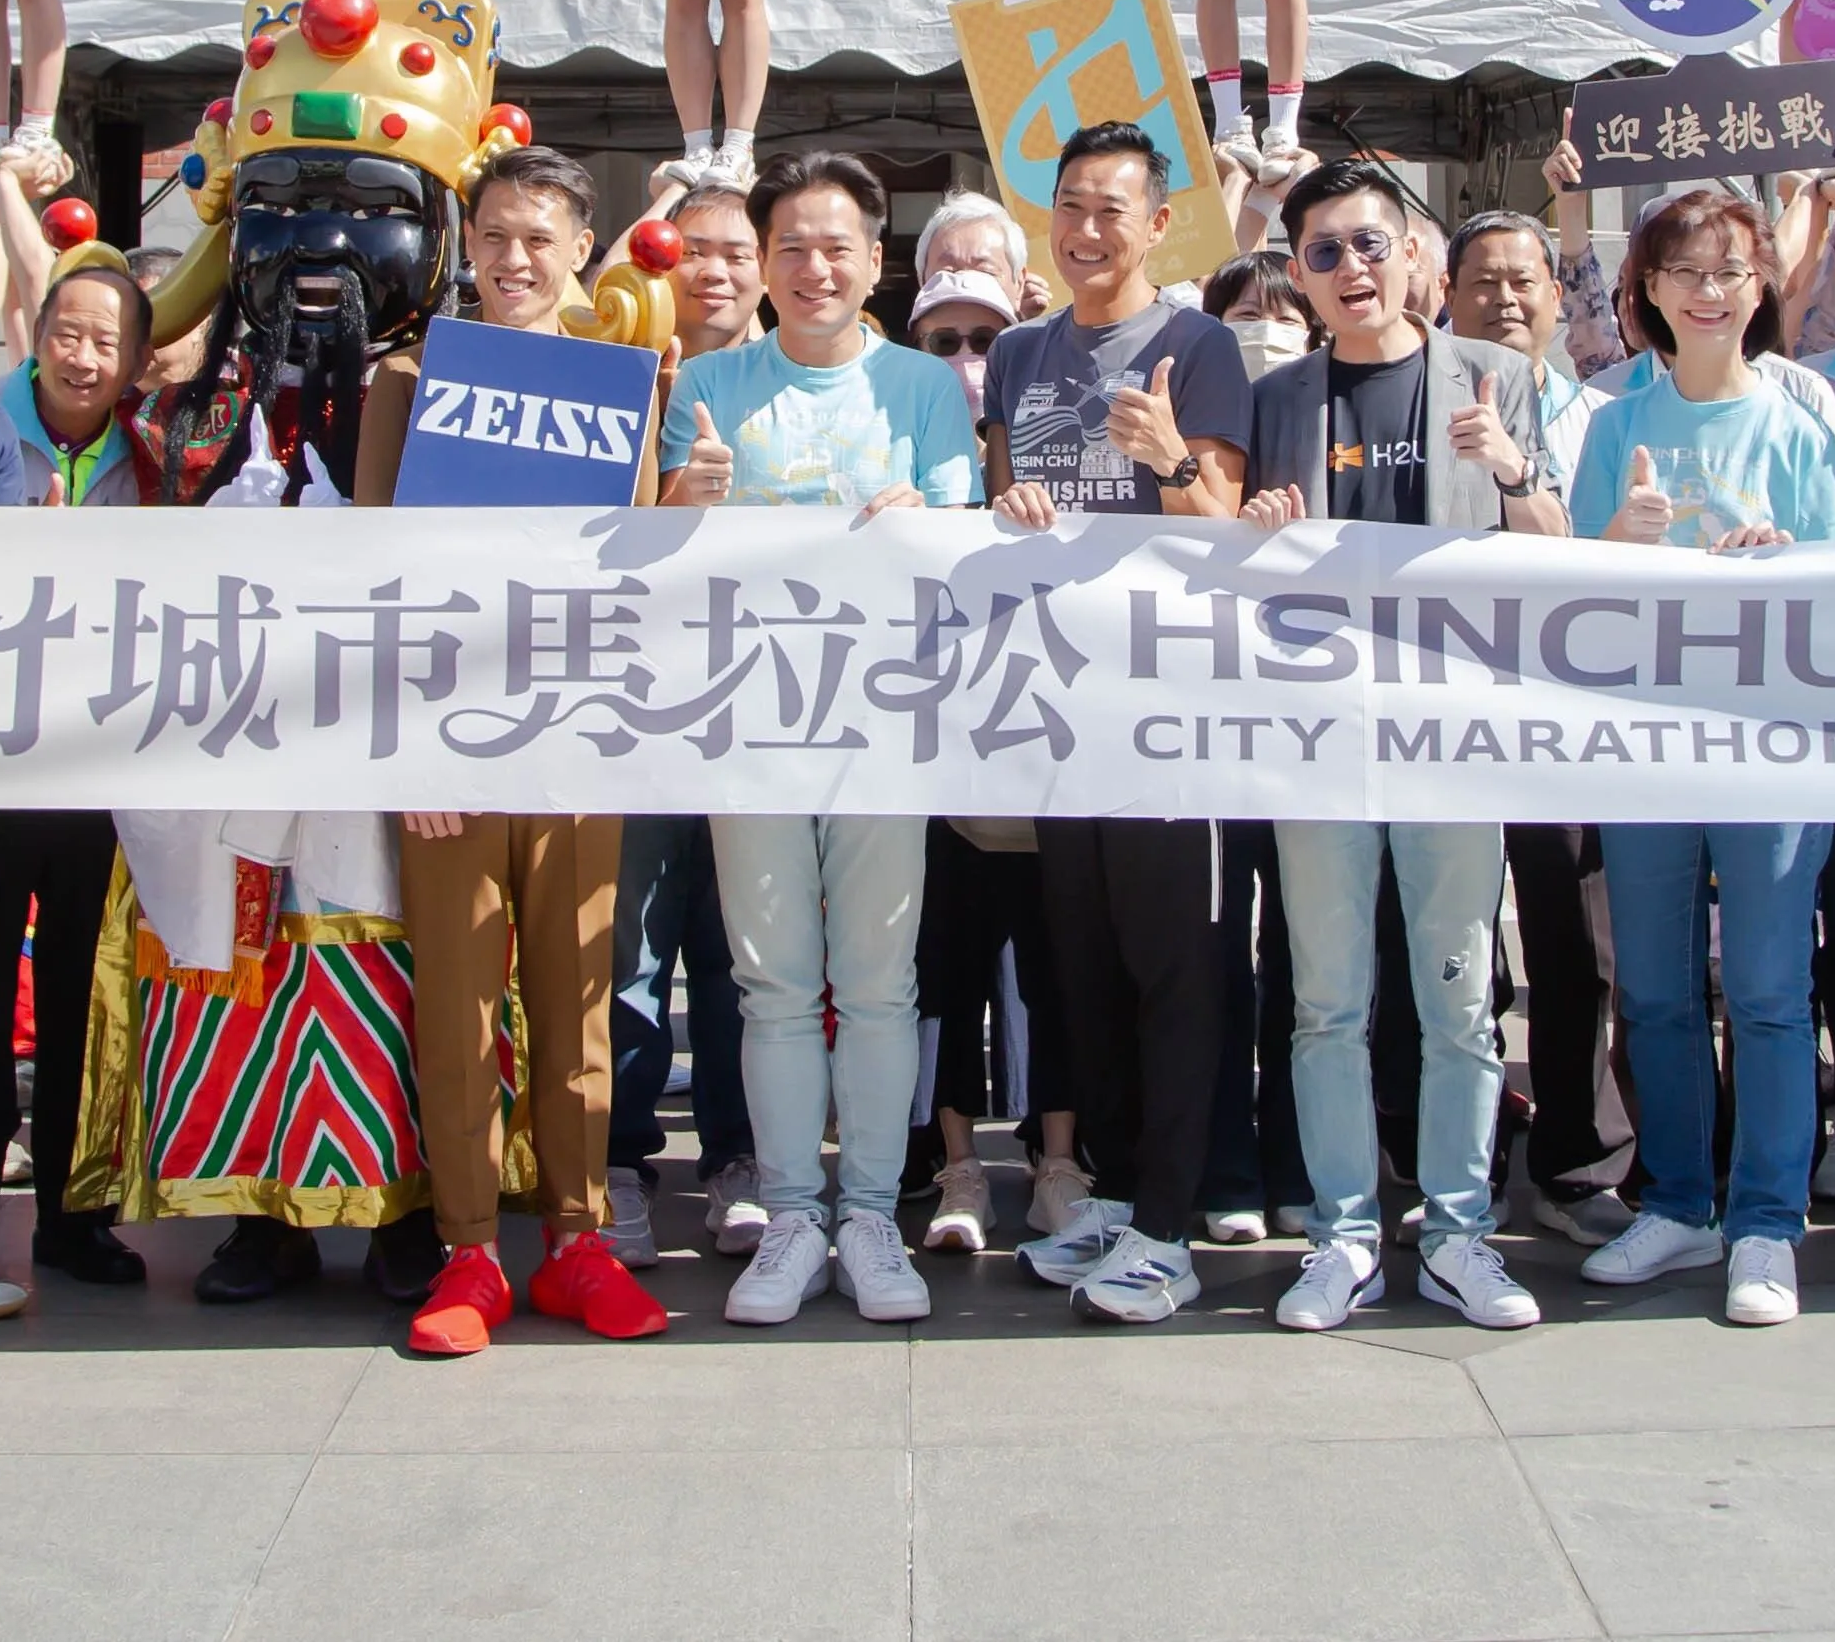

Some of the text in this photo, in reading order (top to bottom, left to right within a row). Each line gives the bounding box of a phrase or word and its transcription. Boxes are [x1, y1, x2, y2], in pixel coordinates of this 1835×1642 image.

[1595, 92, 1833, 162] 迎接挑戰
[416, 378, 640, 466] ZEISS
[1011, 455, 1078, 468] HSIN CHU
[1042, 443, 1079, 454] 2024
[1015, 480, 1137, 502] ISHER
[1132, 715, 1338, 762] CITY
